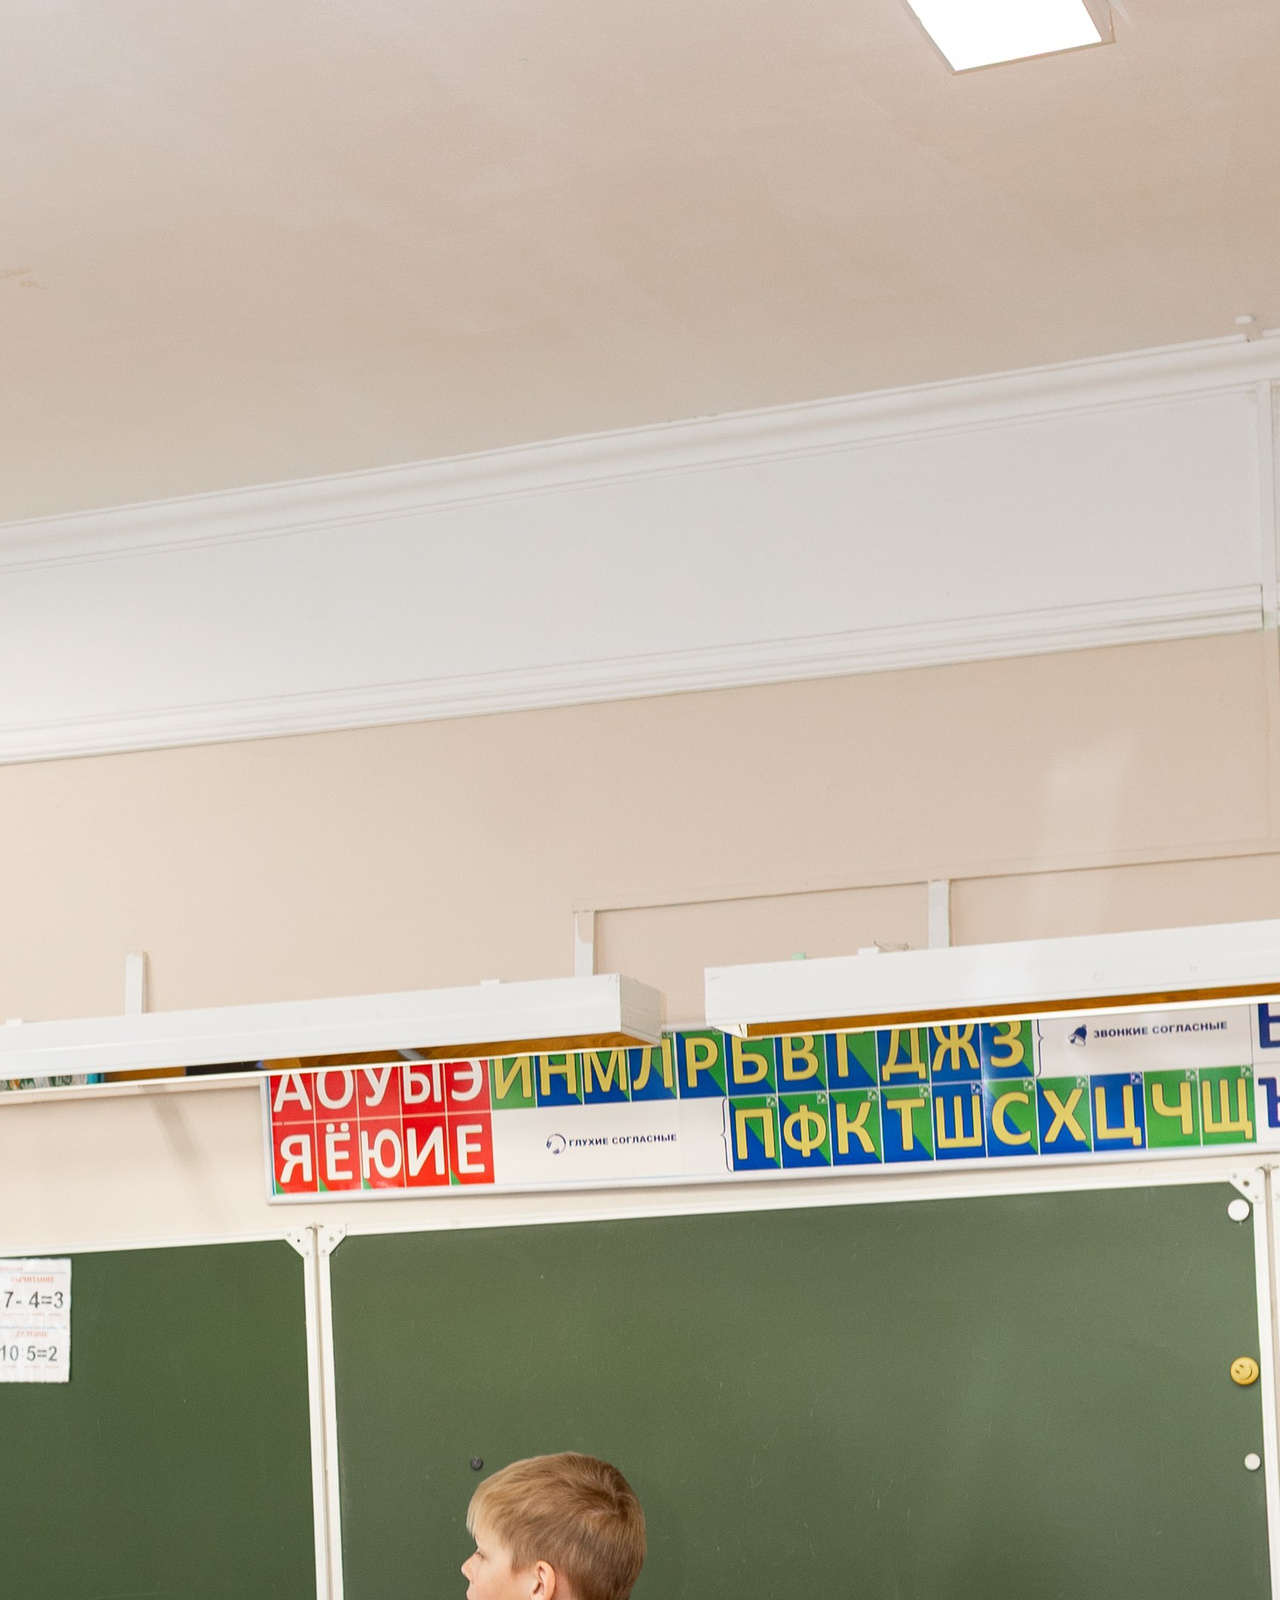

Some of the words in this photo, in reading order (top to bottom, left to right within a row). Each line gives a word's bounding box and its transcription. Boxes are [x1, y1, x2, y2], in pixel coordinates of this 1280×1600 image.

[1093, 1026, 1149, 1039] ЗВОНКИЕ
[1151, 1021, 1228, 1034] СОГЛАСНЫЕ
[568, 1137, 609, 1148] ГЛУХИЕ
[611, 1133, 677, 1146] СОГЛАСНЫЕ
